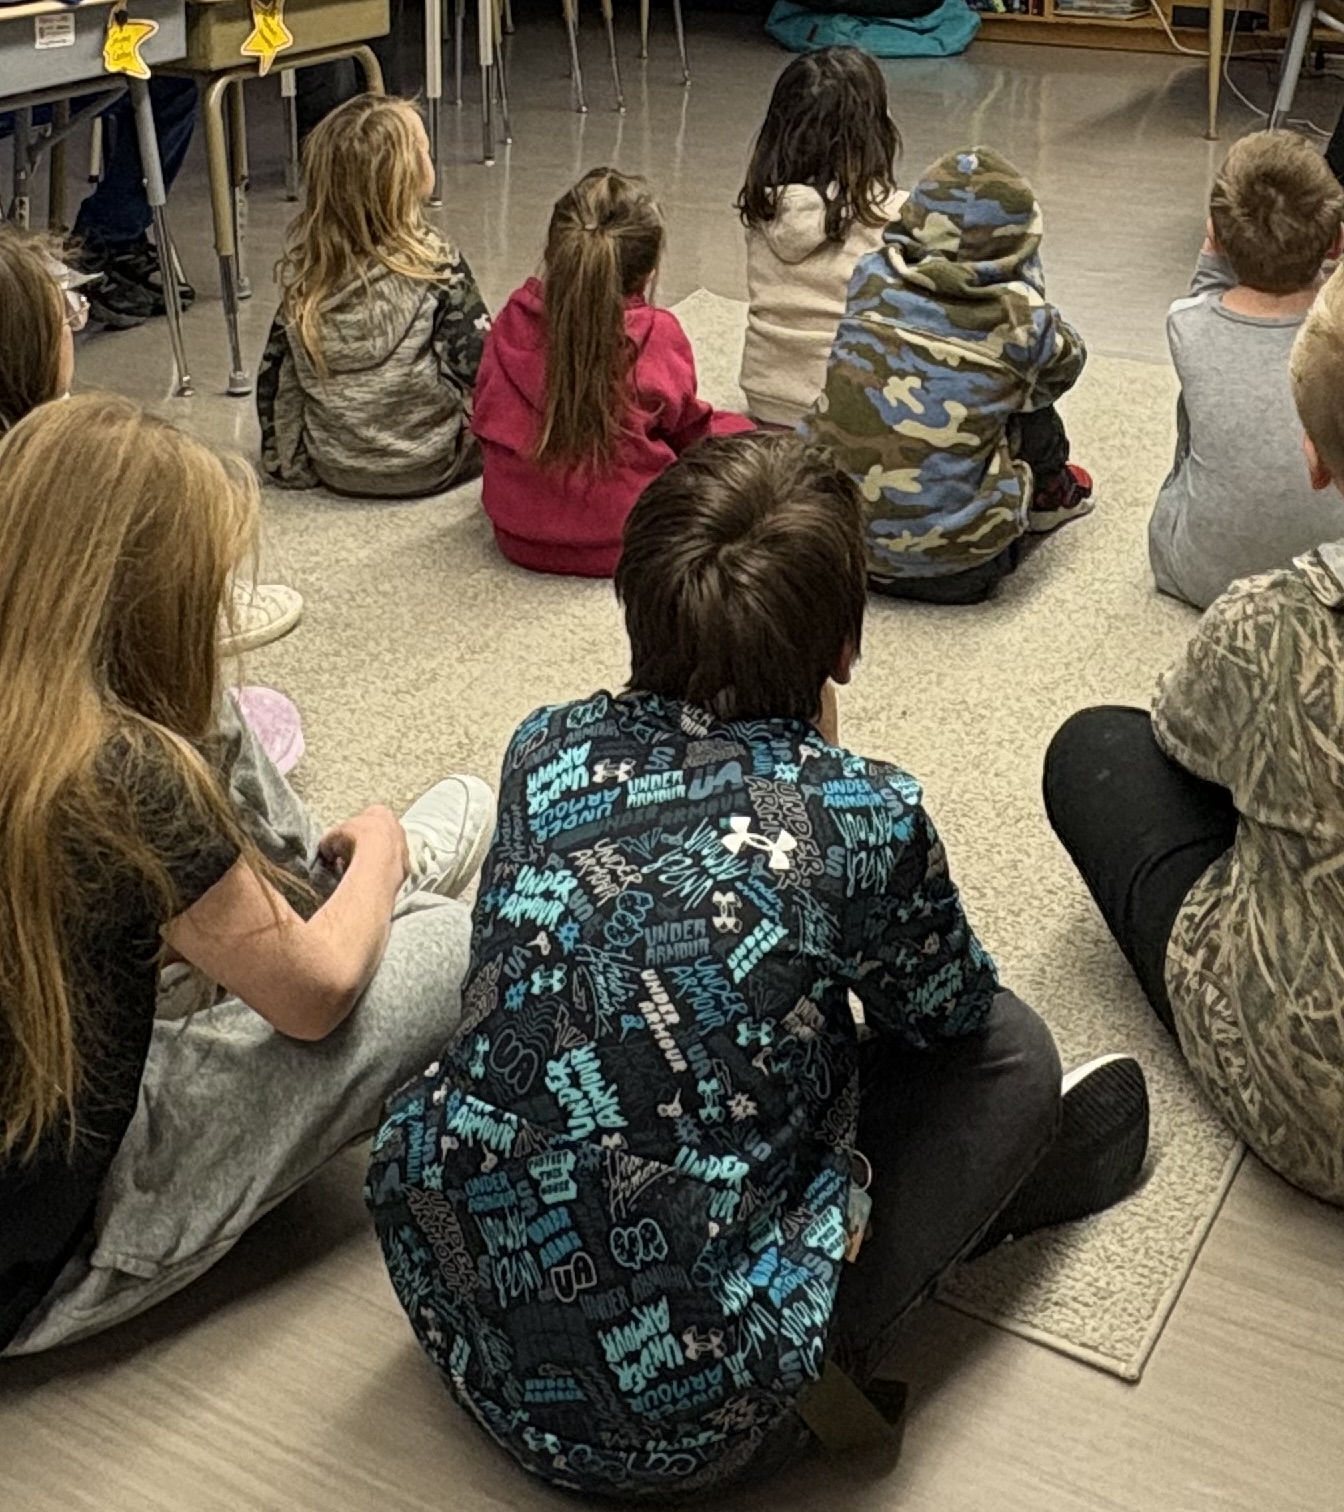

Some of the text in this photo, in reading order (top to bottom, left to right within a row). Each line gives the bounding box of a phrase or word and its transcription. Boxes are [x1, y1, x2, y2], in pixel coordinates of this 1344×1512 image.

[527, 740, 592, 795] ARMOUR
[527, 765, 589, 815] UNDER
[627, 770, 684, 792] UNDER
[626, 784, 686, 808] ARMOUR
[514, 864, 578, 904] UNDER
[497, 892, 566, 932] ARMOUR
[644, 918, 706, 947] UNDER
[645, 937, 710, 966] ARMOUR
[640, 968, 680, 1026] UNDER
[638, 1000, 688, 1074] ARMOUR
[545, 1050, 596, 1140] UNDER
[570, 1040, 626, 1128] ARMOUR
[674, 1143, 751, 1192] UNDER
[551, 1251, 598, 1304] UA
[597, 1294, 671, 1363] ARMOUR
[608, 1332, 685, 1393] UNDER
